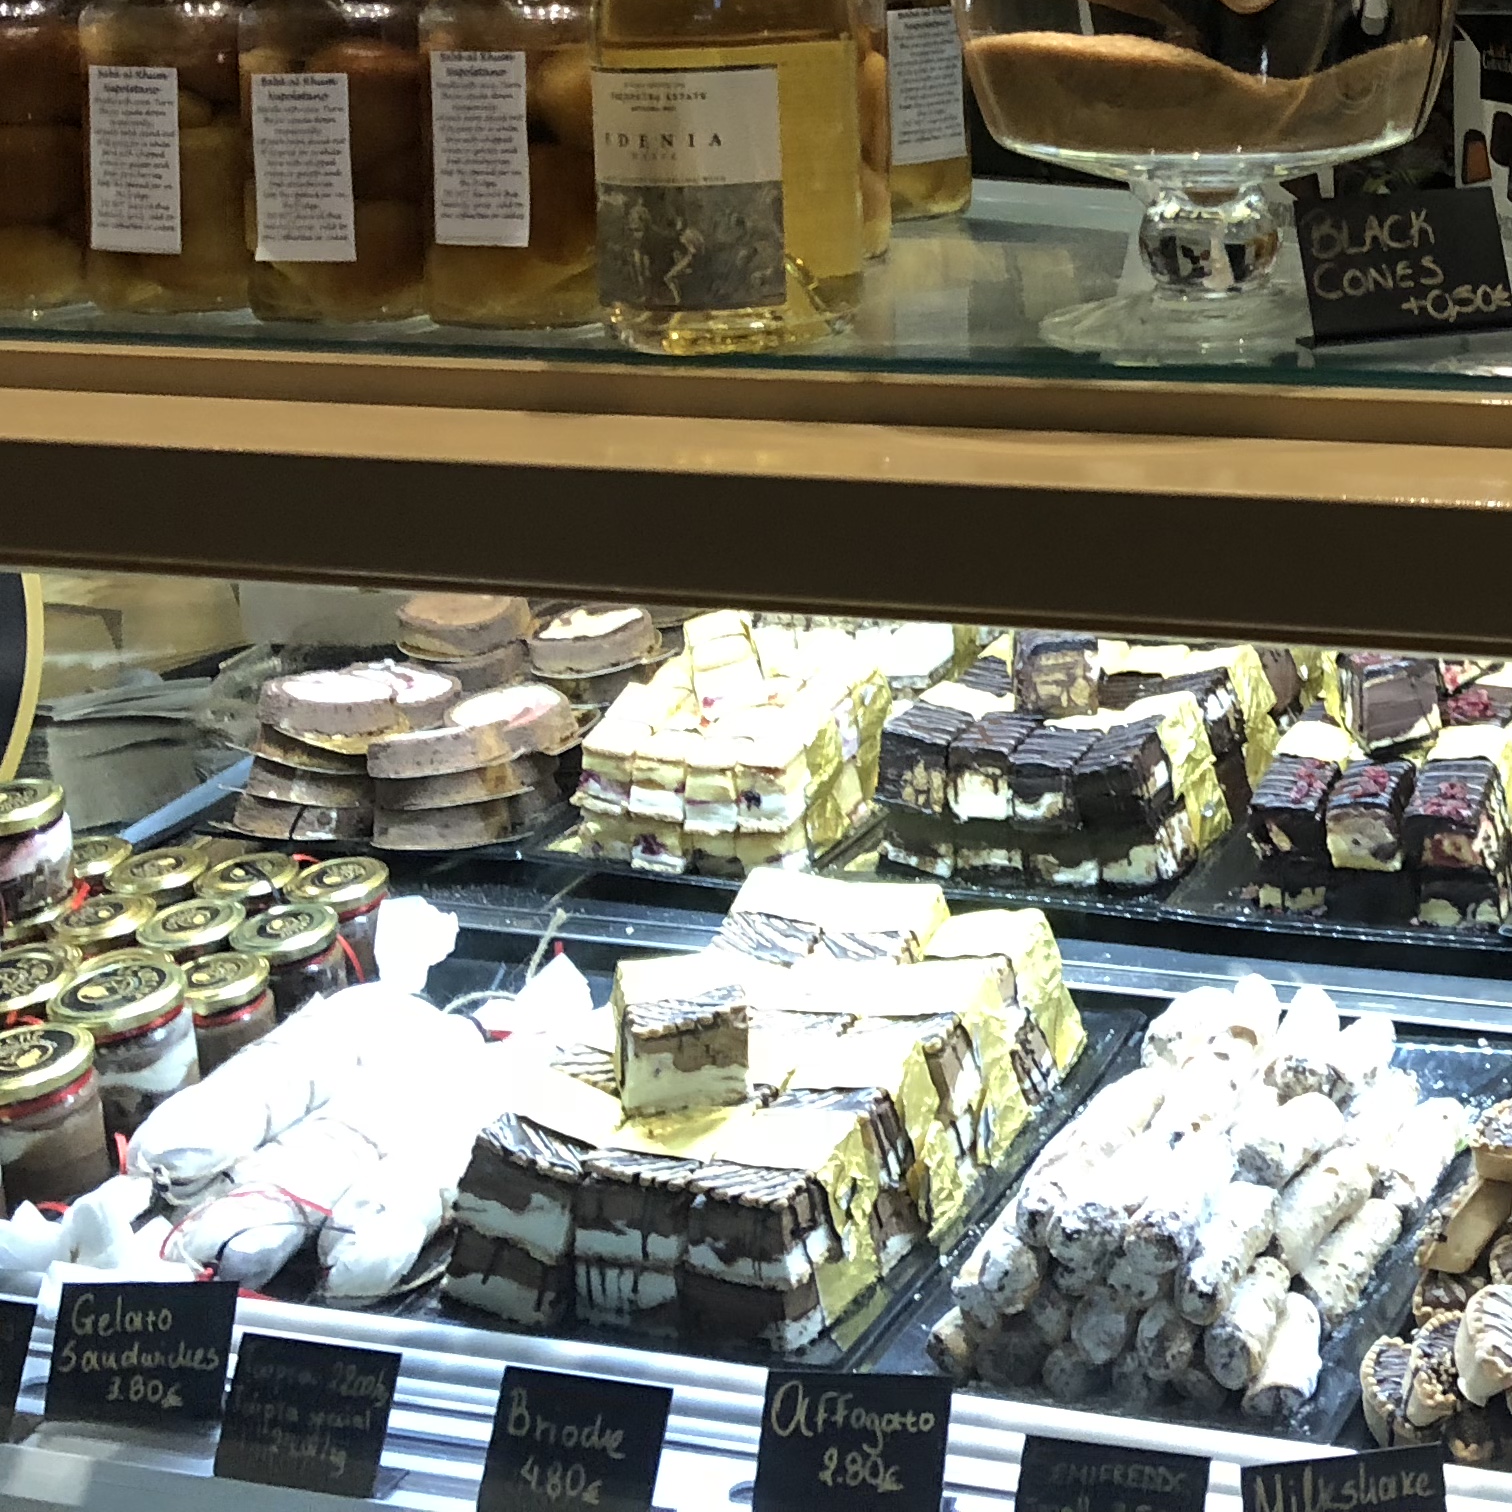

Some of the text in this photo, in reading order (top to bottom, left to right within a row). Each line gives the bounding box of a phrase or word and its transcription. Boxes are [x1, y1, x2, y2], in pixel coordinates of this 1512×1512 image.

[1309, 207, 1436, 260] BLACK
[1313, 255, 1445, 301] CONES
[71, 1294, 174, 1337] Gelato
[58, 1339, 221, 1375] Sandwiches
